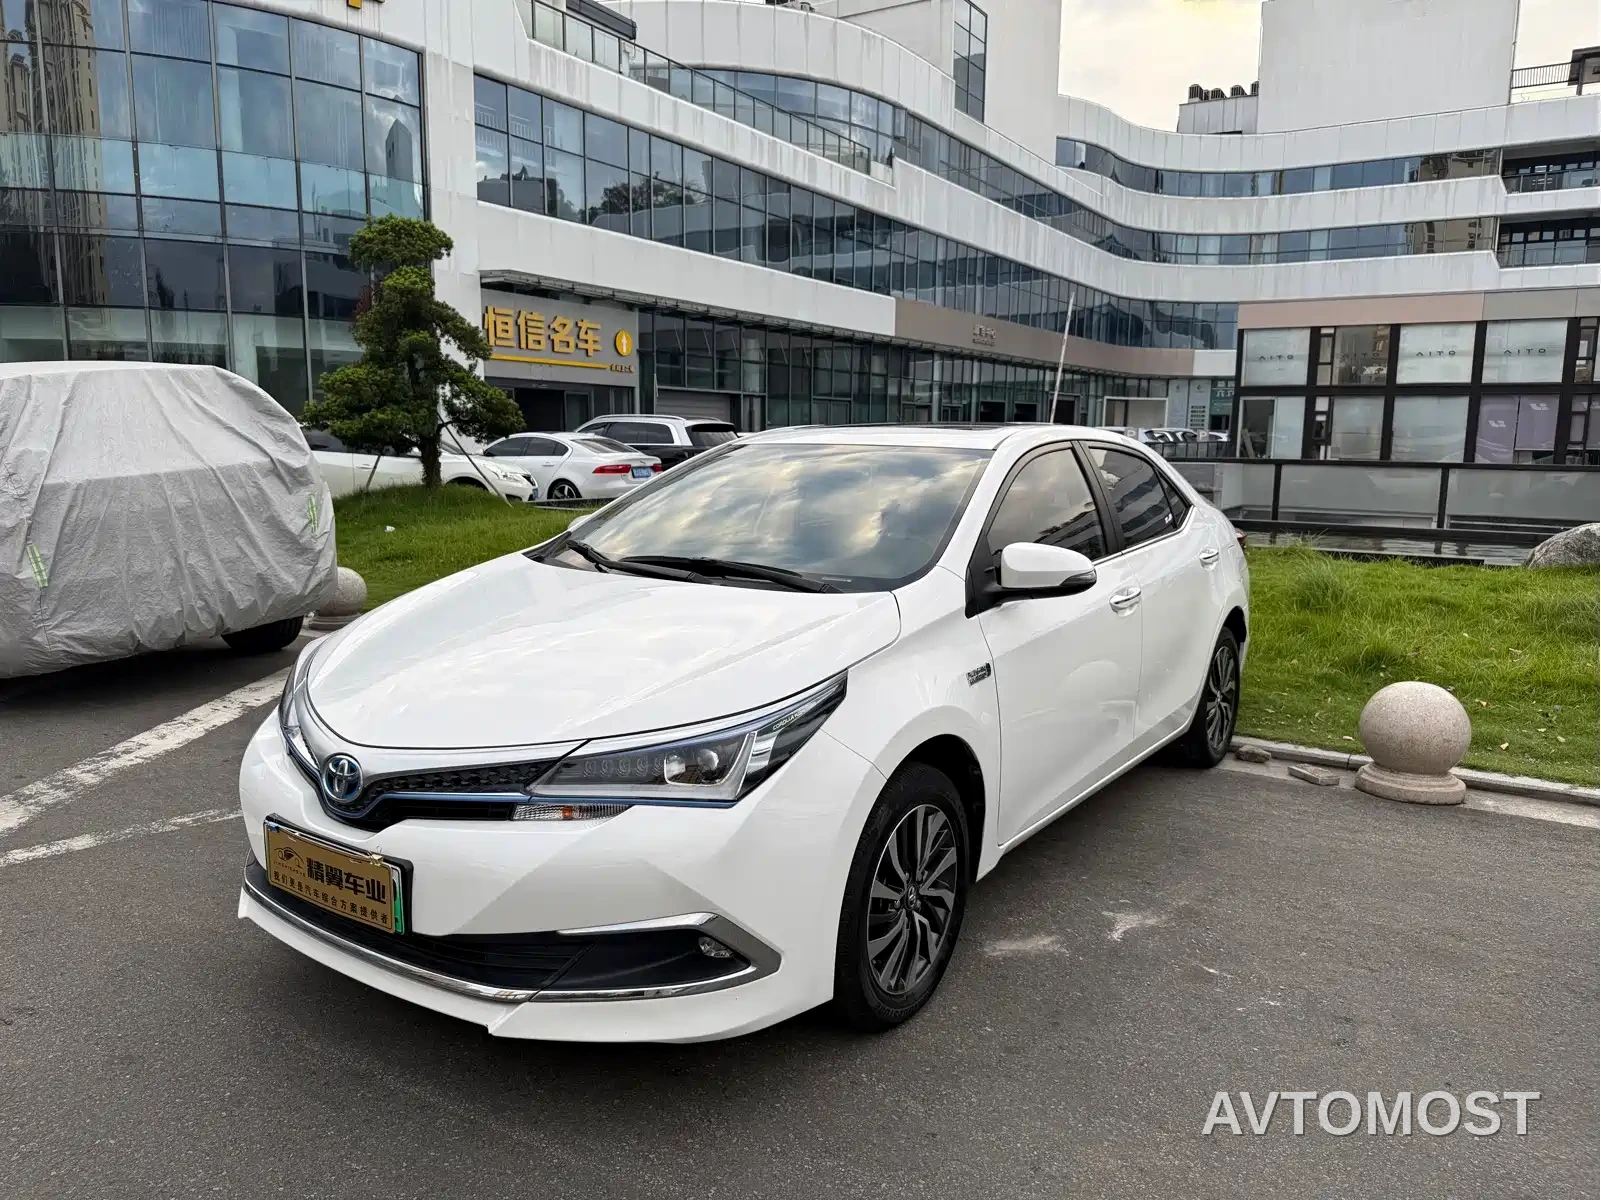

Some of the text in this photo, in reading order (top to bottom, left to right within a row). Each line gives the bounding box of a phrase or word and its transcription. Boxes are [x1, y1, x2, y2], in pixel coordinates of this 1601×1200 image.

[484, 305, 602, 357] 恒信名车
[772, 714, 795, 731] COROLLA
[306, 857, 387, 905] 精翼车业
